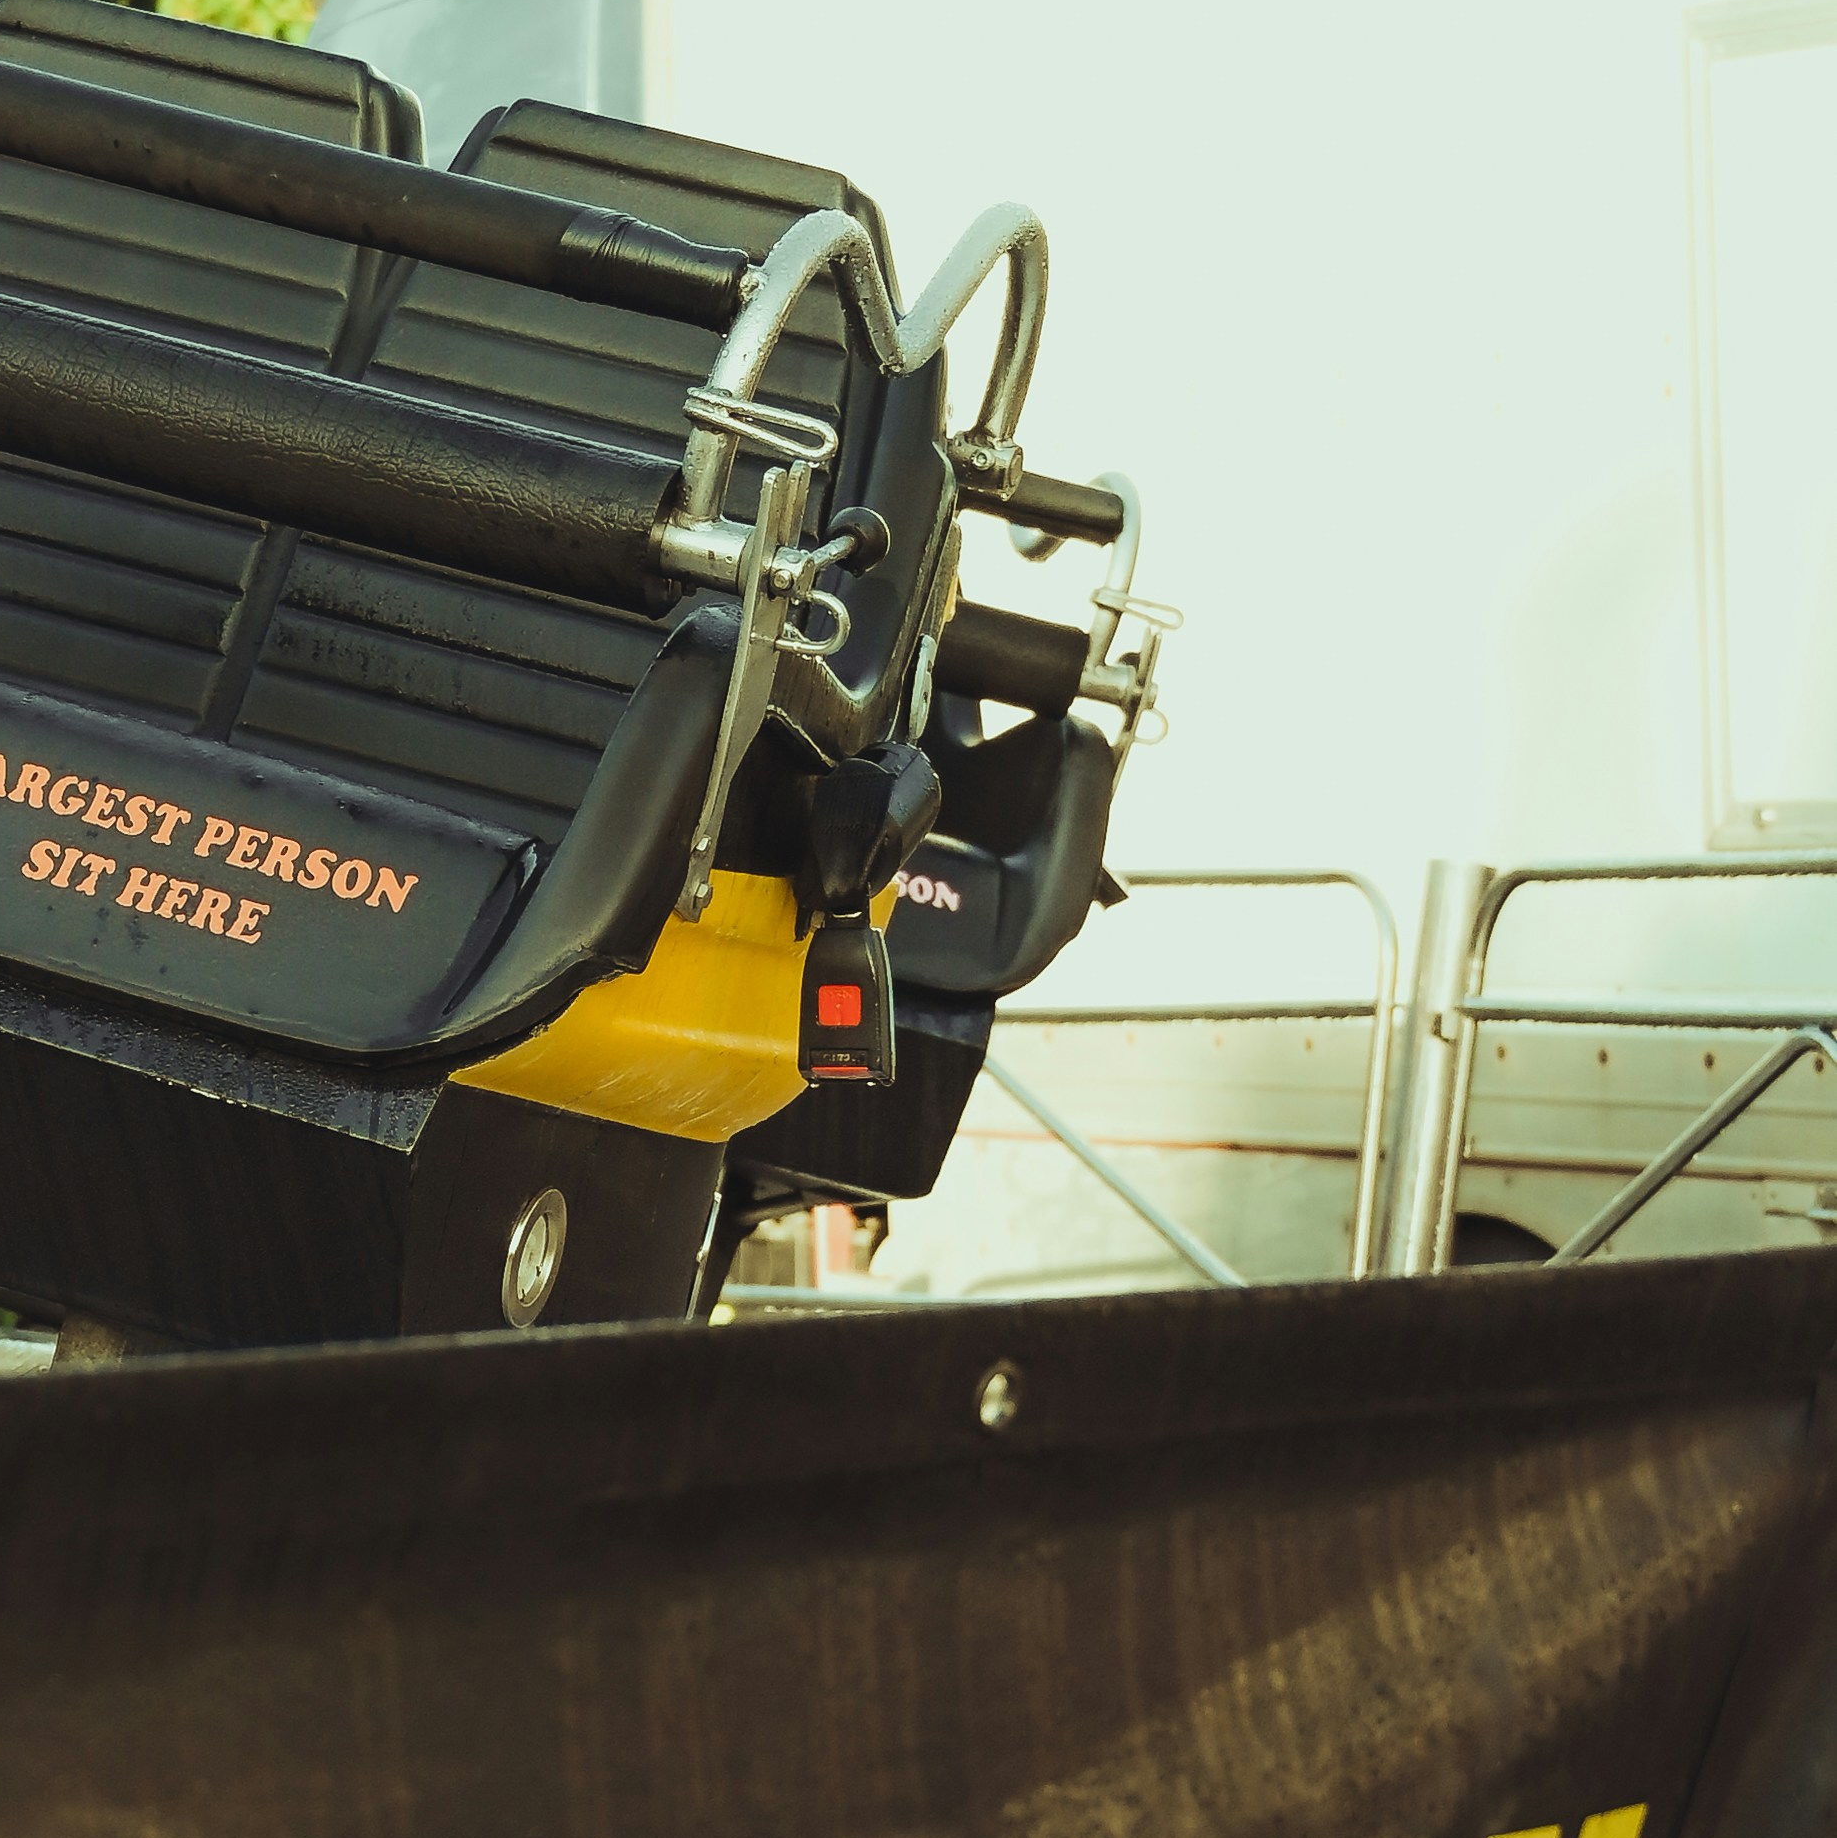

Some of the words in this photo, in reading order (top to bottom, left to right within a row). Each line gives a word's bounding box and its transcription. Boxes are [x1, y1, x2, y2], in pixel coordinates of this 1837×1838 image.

[21, 840, 117, 896] SIT
[116, 867, 271, 944] HERE
[194, 816, 418, 913] PERSON
